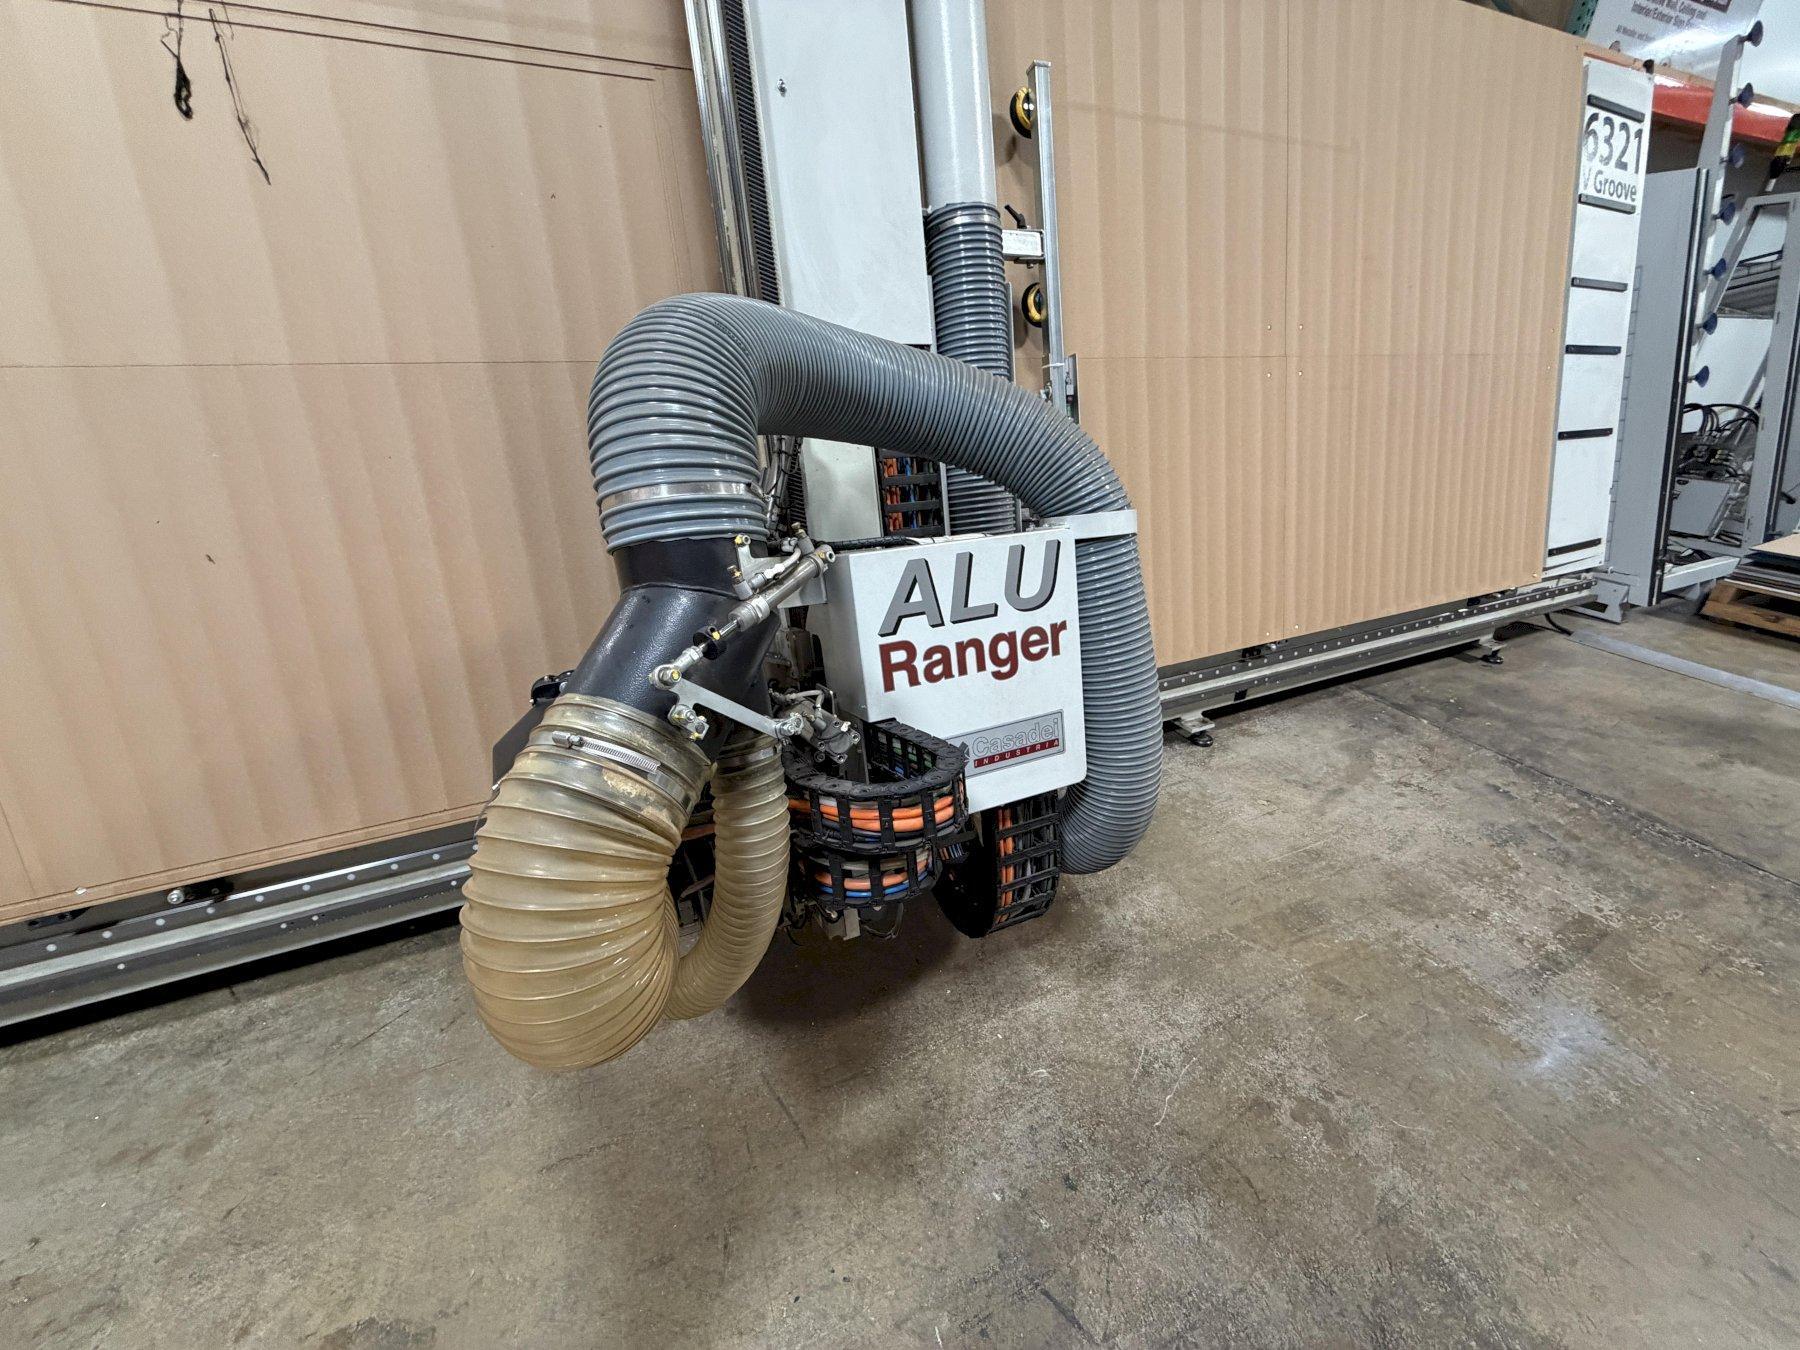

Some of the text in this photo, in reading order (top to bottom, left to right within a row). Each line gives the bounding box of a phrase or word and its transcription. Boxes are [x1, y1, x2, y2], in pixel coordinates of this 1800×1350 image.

[1583, 112, 1643, 174] 6321
[1594, 170, 1637, 202] Groove
[878, 539, 1061, 638] ALU
[878, 620, 1067, 693] Ranger
[972, 717, 1059, 757] Casadei
[974, 739, 1060, 767] INDUSTRIA
